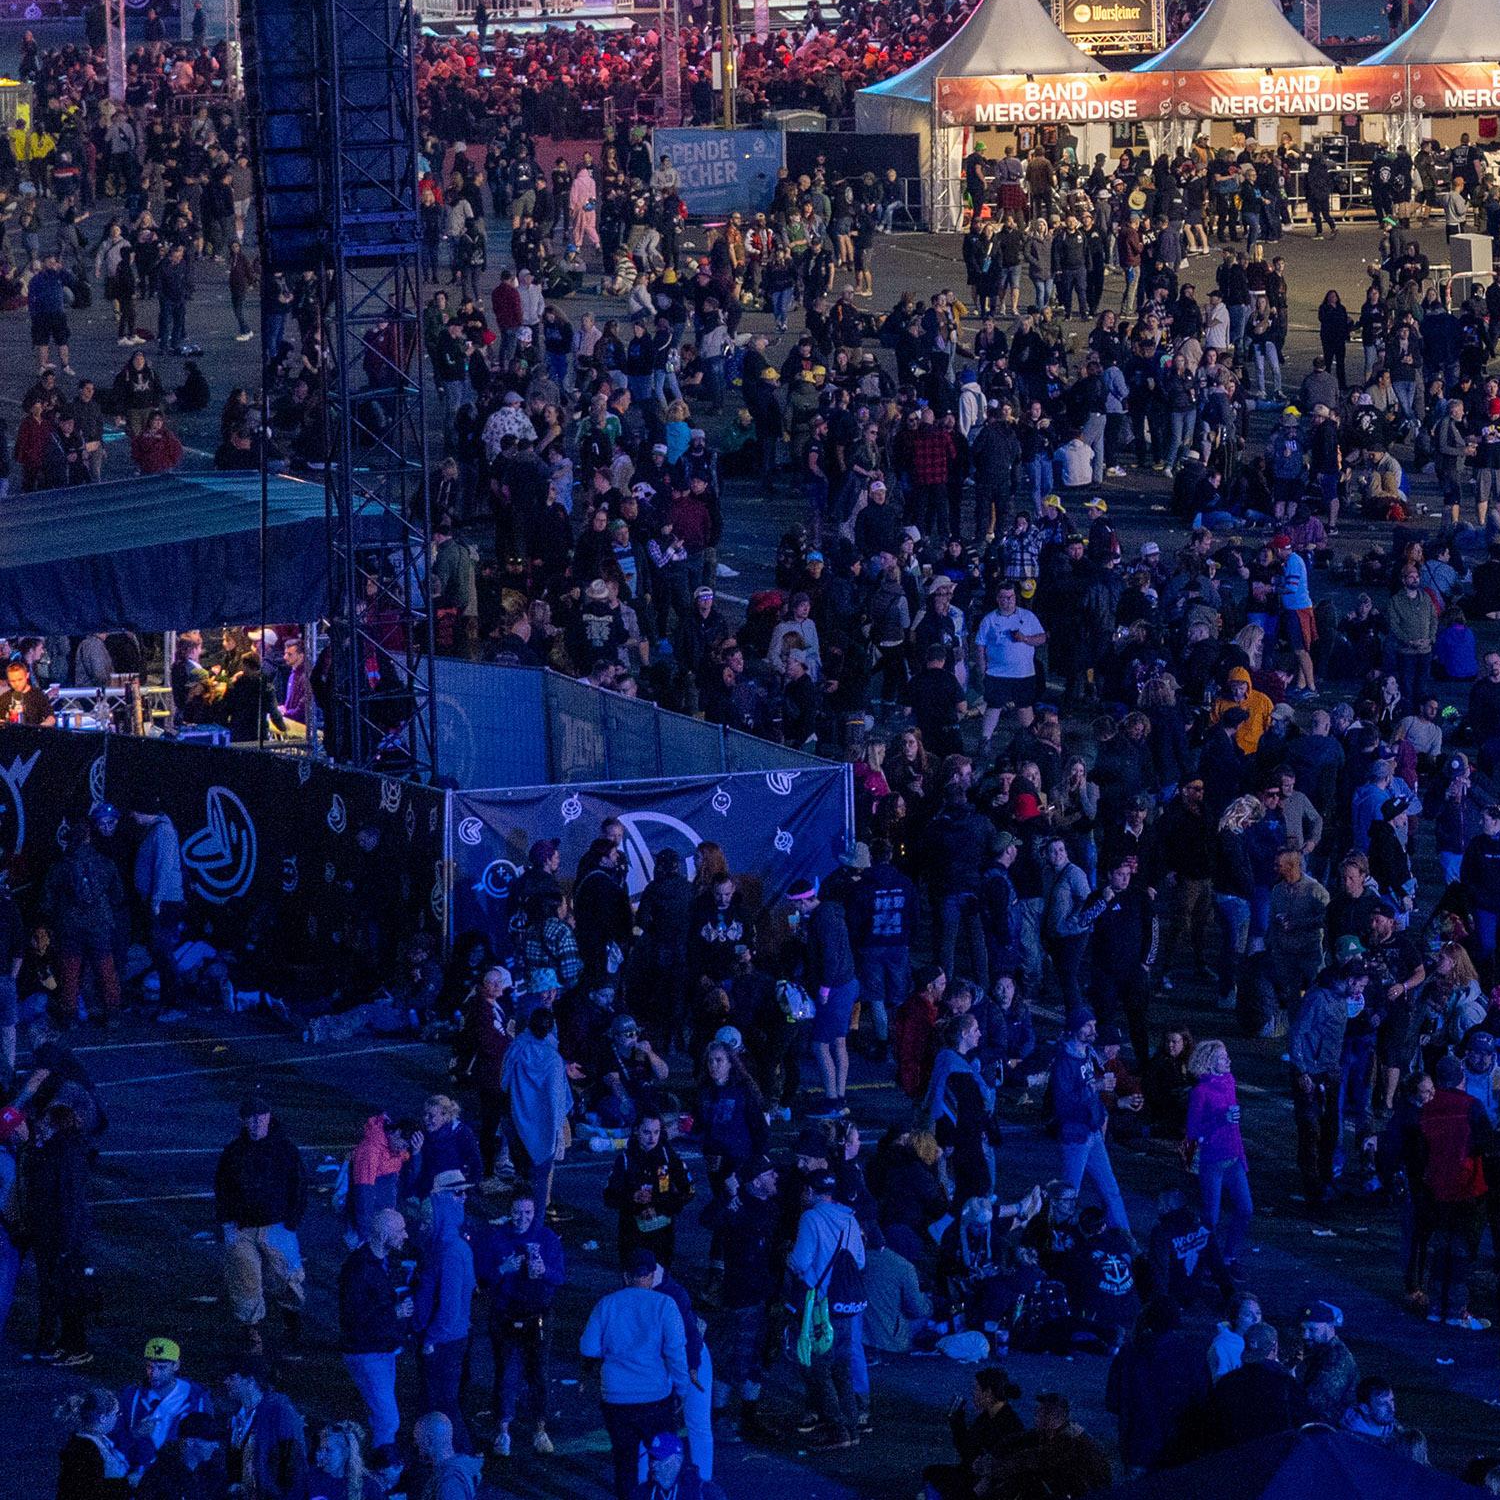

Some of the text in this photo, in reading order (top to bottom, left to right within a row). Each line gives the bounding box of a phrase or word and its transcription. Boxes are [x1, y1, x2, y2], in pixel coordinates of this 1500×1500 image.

[1093, 4, 1141, 22] Warsteiner
[1025, 81, 1088, 102] BAND
[1259, 74, 1321, 95] BAND
[975, 100, 1138, 123] MERCHANDISE
[1211, 92, 1369, 115] MERCHANDISE
